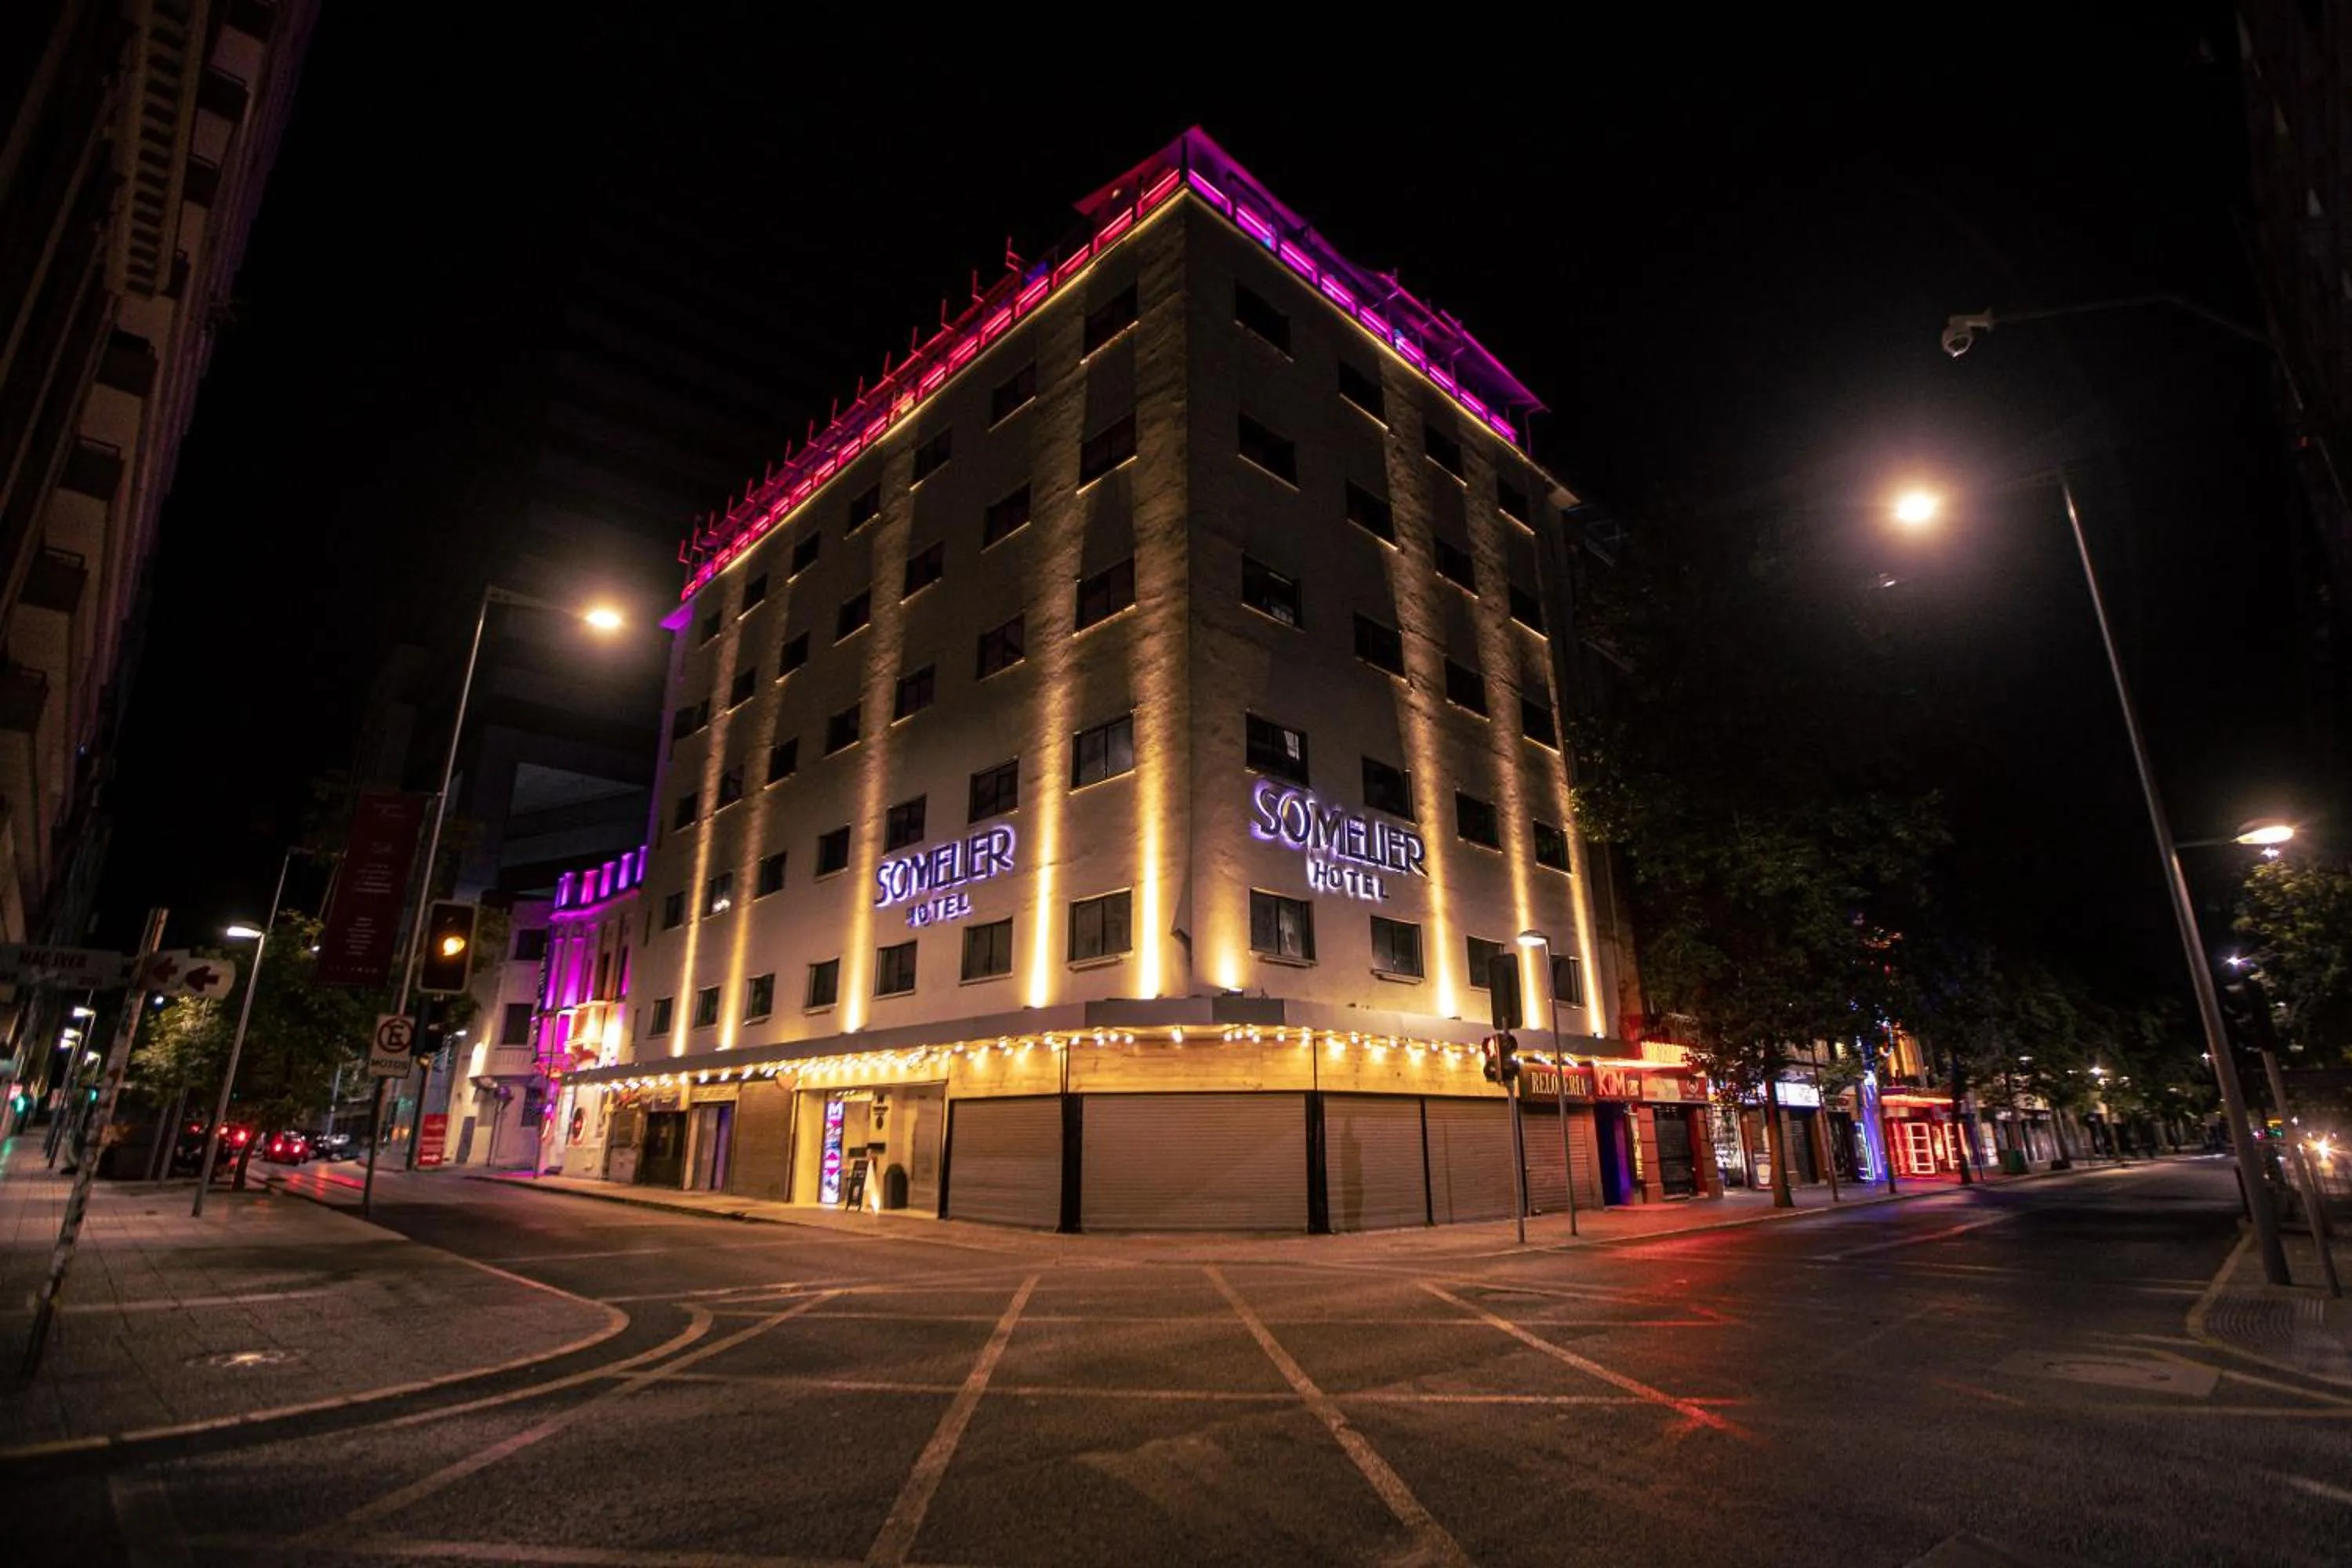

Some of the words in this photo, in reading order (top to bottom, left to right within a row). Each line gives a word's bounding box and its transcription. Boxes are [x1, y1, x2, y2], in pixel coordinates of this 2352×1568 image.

[1251, 786, 1428, 877] SOMELIER
[874, 827, 1014, 906] SOMELIER
[1312, 861, 1389, 899] HOTEL
[906, 893, 971, 926] HOTEL
[370, 1058, 408, 1069] MOTOS
[1531, 1072, 1586, 1095] RELOERIA
